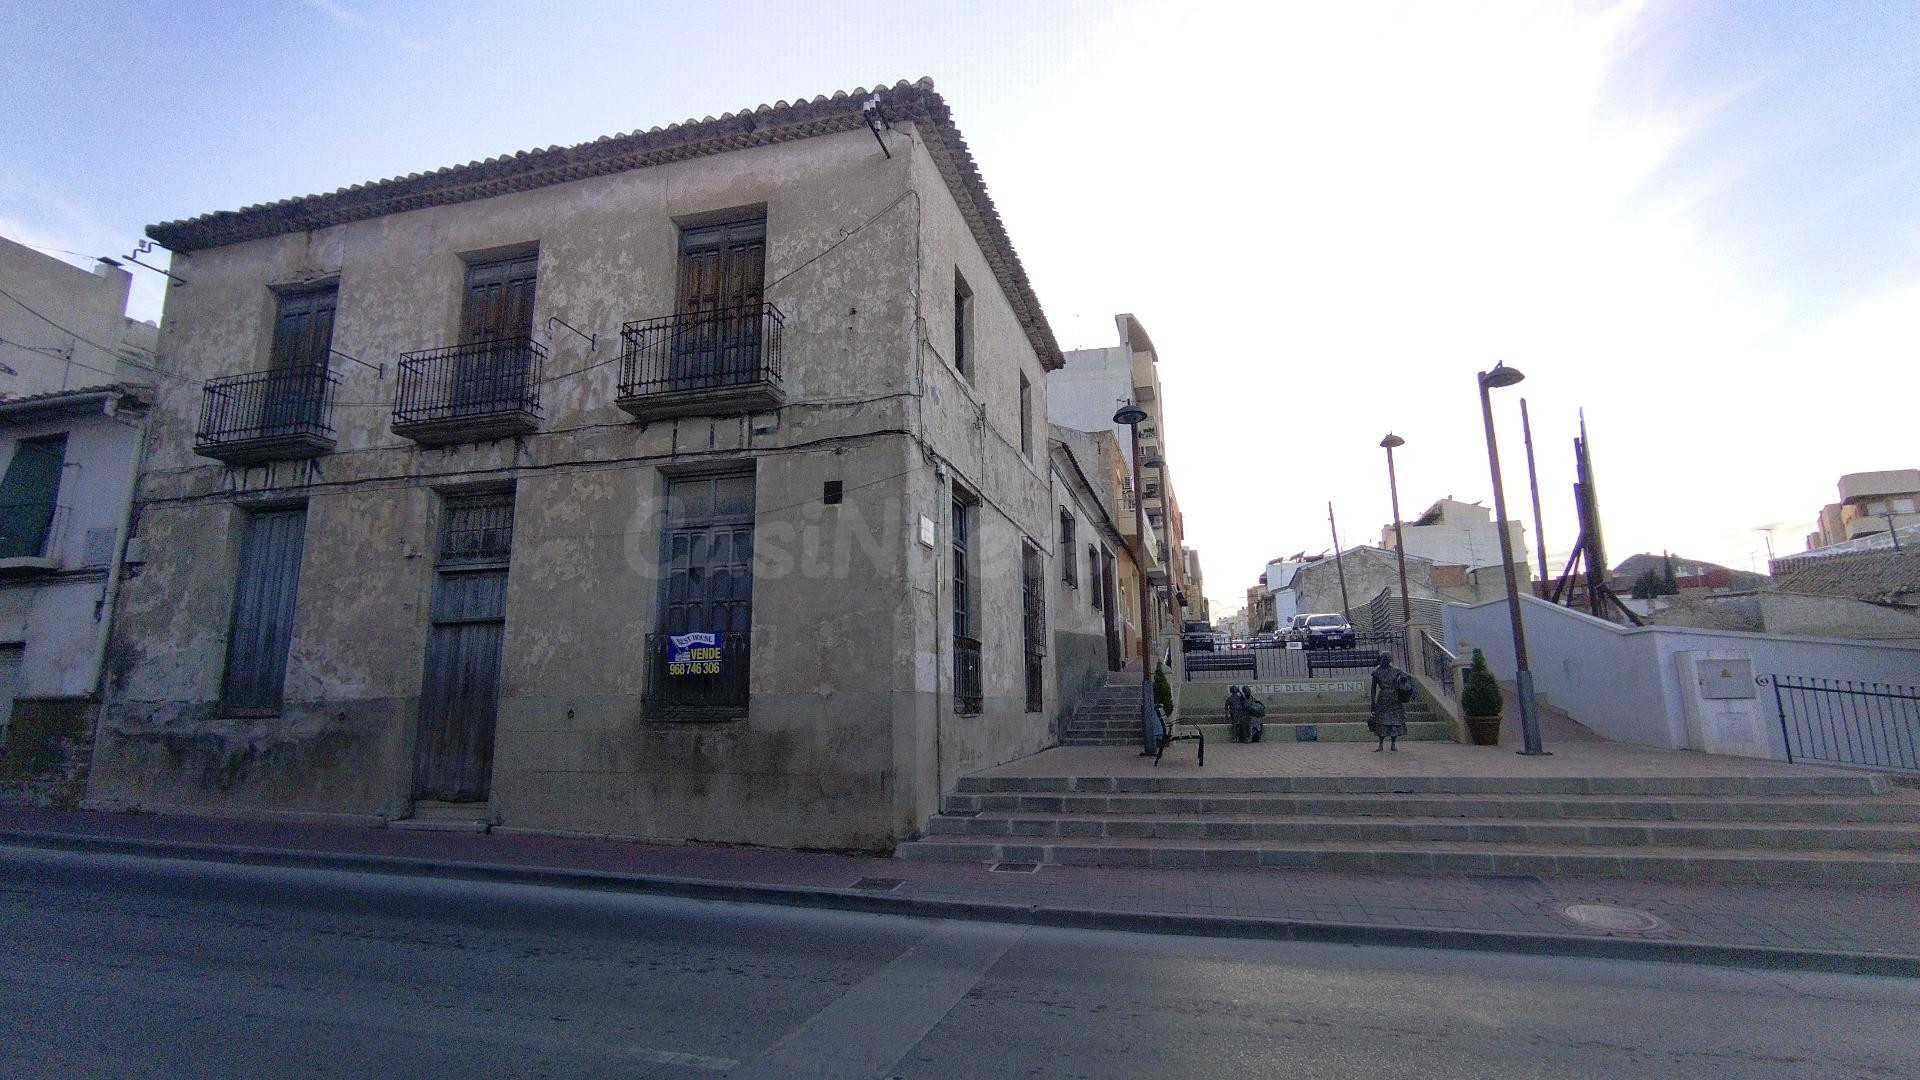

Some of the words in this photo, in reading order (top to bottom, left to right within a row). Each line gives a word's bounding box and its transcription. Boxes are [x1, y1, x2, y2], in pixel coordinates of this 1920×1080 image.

[692, 634, 713, 643] HOUSE
[690, 647, 721, 659] VENDE
[669, 663, 685, 675] 968
[686, 662, 701, 674] 746
[703, 661, 719, 673] 306
[1286, 684, 1304, 692] DEL
[1310, 682, 1363, 692] SECANO
